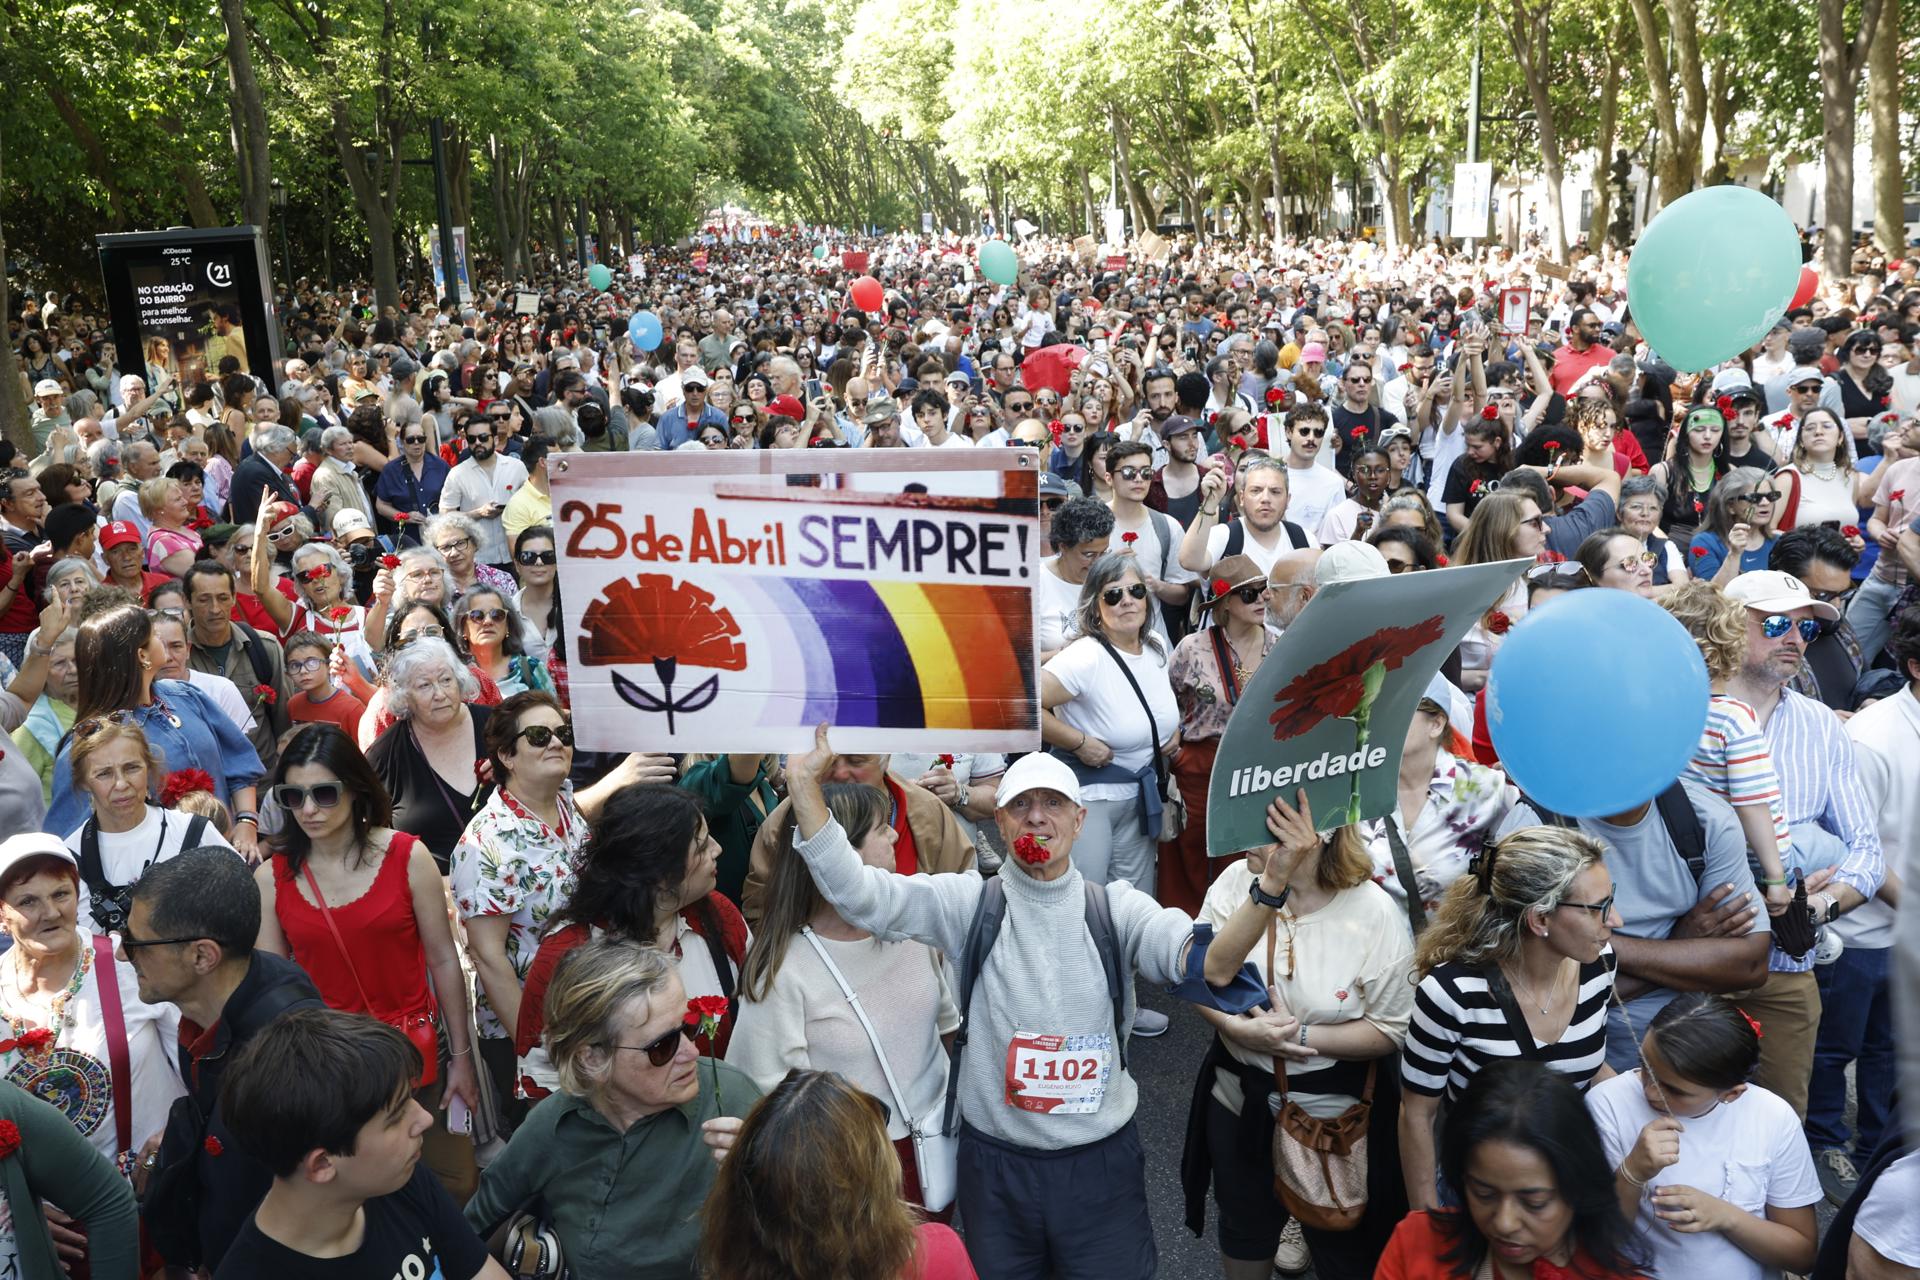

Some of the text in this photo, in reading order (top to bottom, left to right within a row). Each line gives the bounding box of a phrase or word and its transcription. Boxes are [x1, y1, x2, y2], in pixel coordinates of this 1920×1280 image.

[170, 258, 180, 266] 25
[152, 282, 194, 294] CORAÇÃO
[154, 295, 186, 304] BAIRRO
[142, 306, 187, 318] para melhor
[150, 316, 193, 325] aconselhar.
[560, 500, 1030, 579] 25 de Abril SEMPRE!
[1229, 744, 1387, 798] liberdade
[1023, 1058, 1097, 1081] 1102
